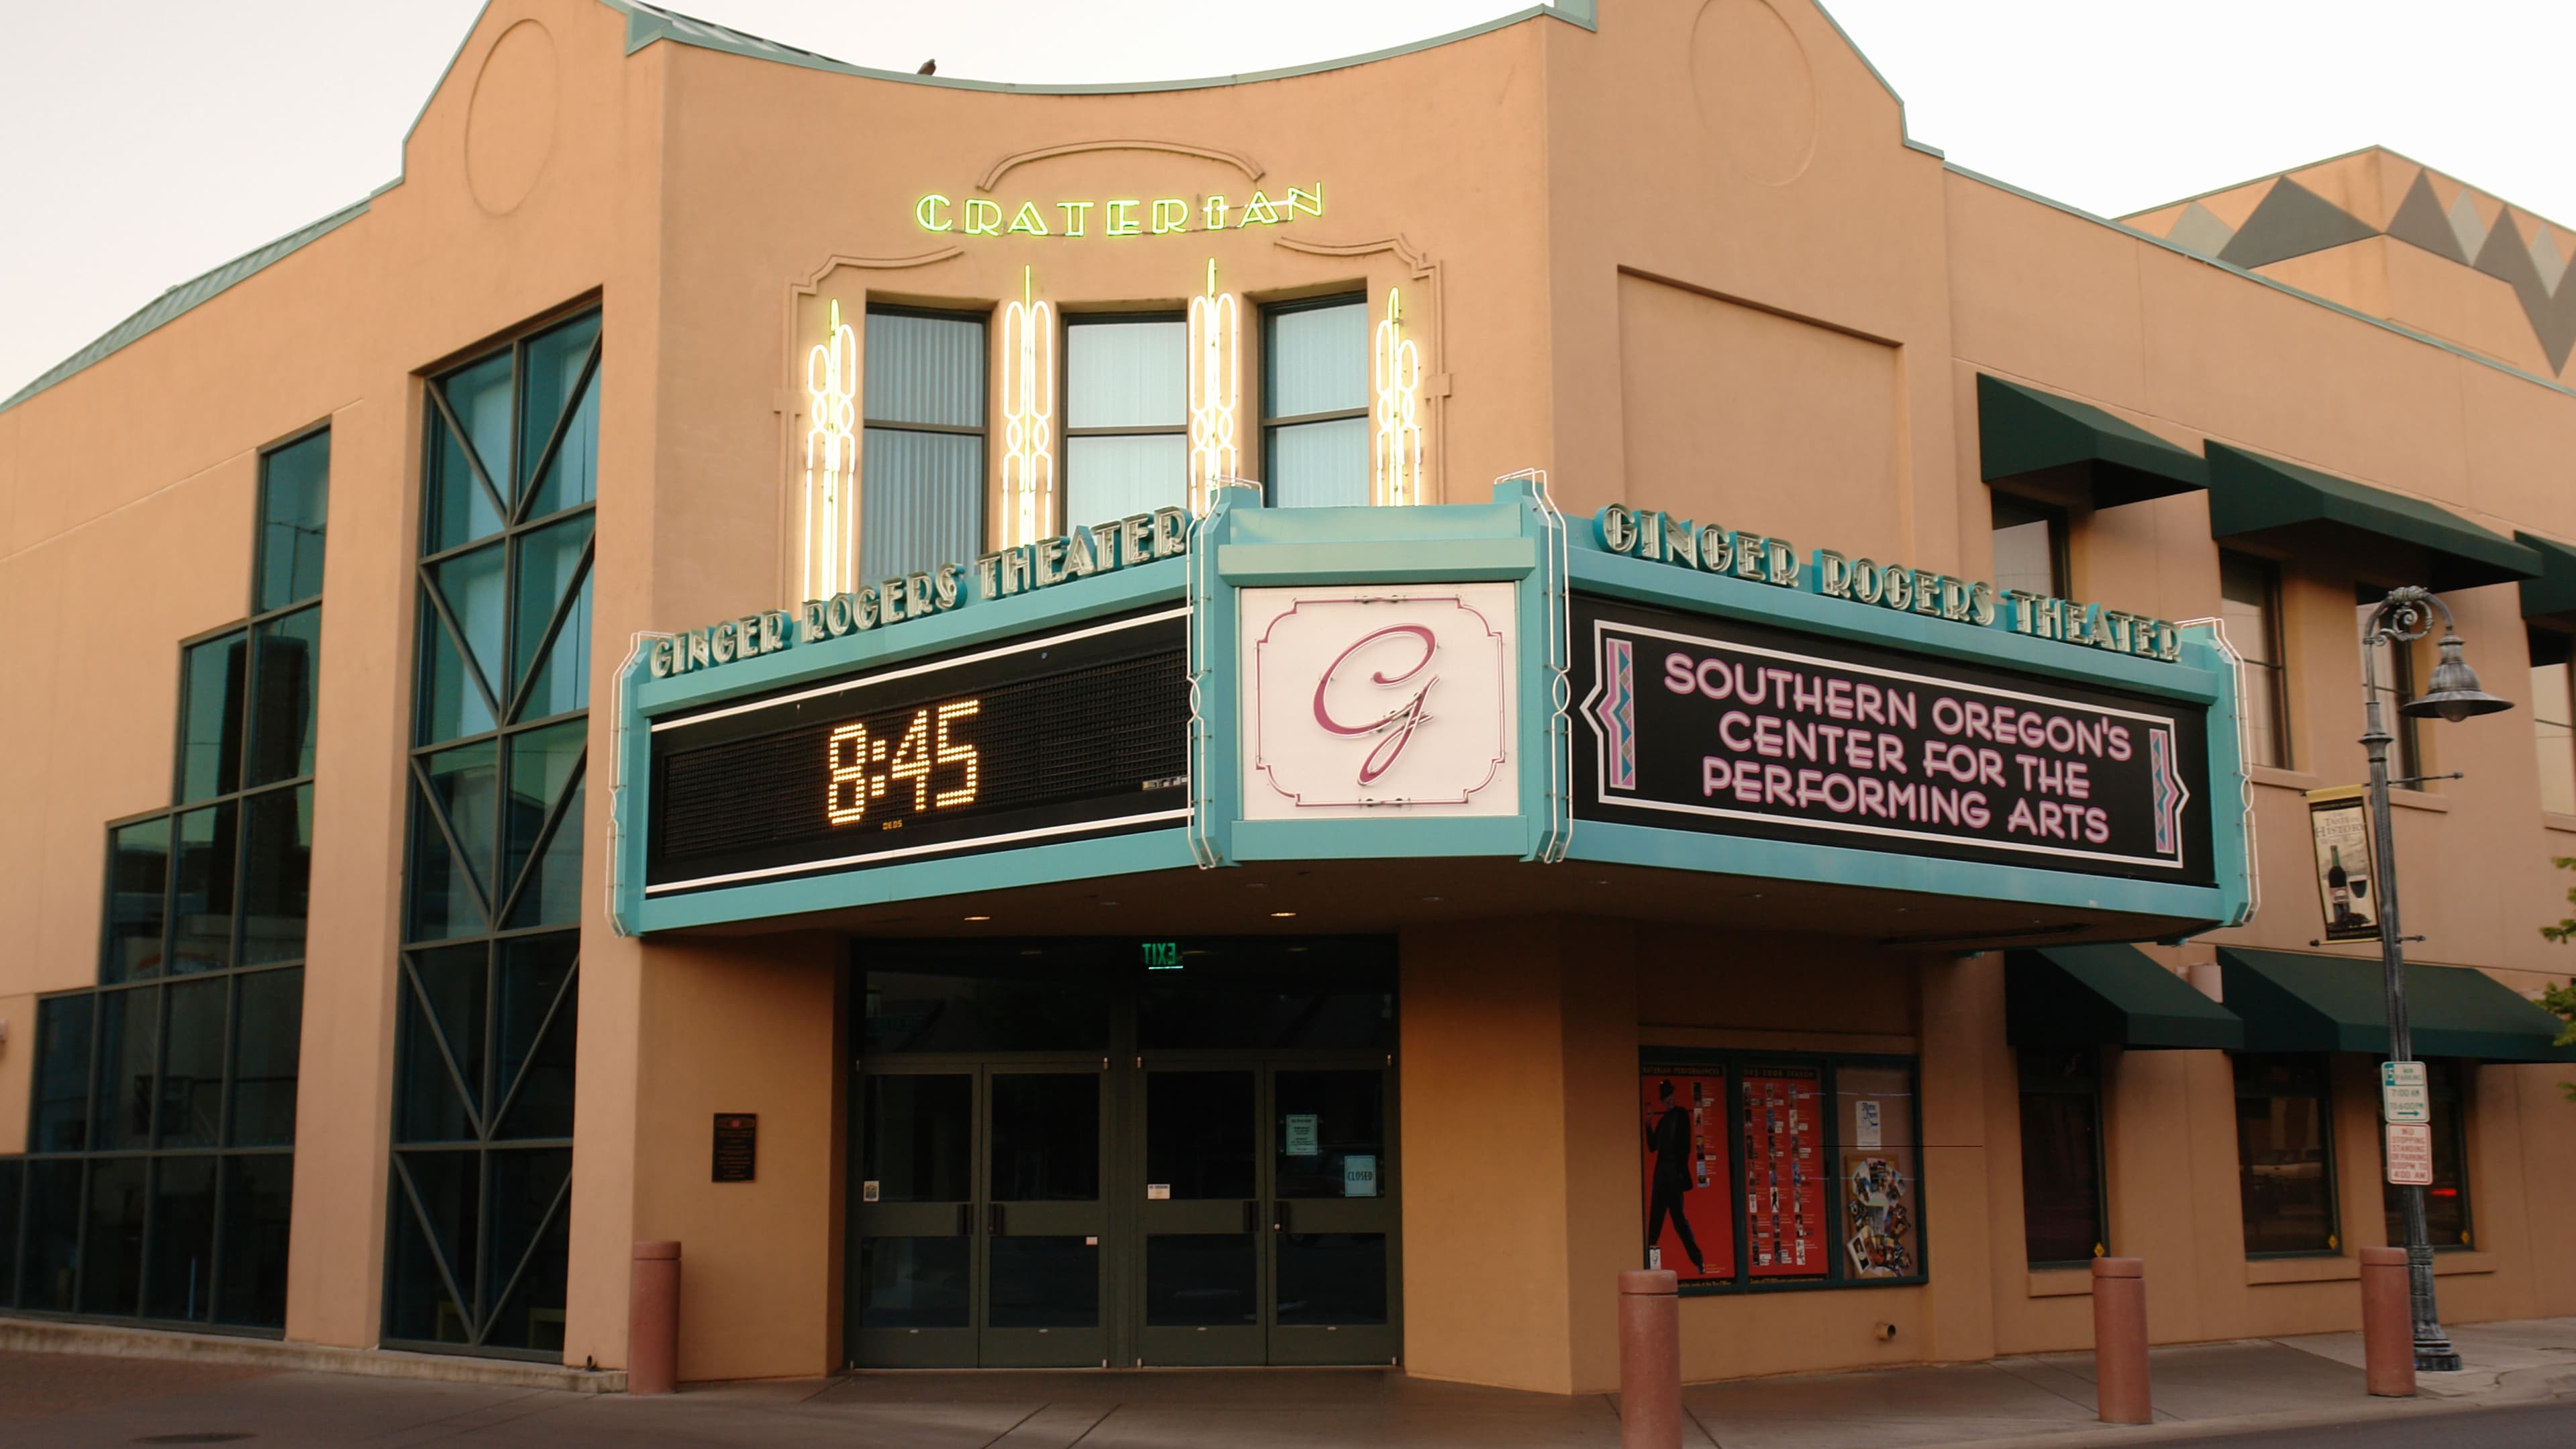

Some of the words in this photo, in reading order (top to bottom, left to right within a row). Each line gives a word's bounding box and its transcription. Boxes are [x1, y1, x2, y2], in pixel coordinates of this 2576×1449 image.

[915, 181, 1323, 237] CRATERIAN
[650, 610, 790, 678] GINGER
[801, 562, 964, 642] ROGERS
[976, 506, 1189, 599] THEATER
[1592, 504, 1799, 587] GINGER
[1814, 549, 1994, 626] ROGERS
[2002, 590, 2181, 662] THEATER
[1665, 653, 1917, 729] SOUTHERN
[1933, 698, 2132, 761] OREGON'S
[1719, 711, 1907, 773] CENTER
[1923, 740, 2006, 787] FOR
[2015, 754, 2090, 799] THE
[828, 699, 978, 825] 8:45
[1702, 756, 1990, 828] PERFORMING
[2008, 797, 2109, 843] ARTS
[1347, 1170, 1374, 1181] CLOSED
